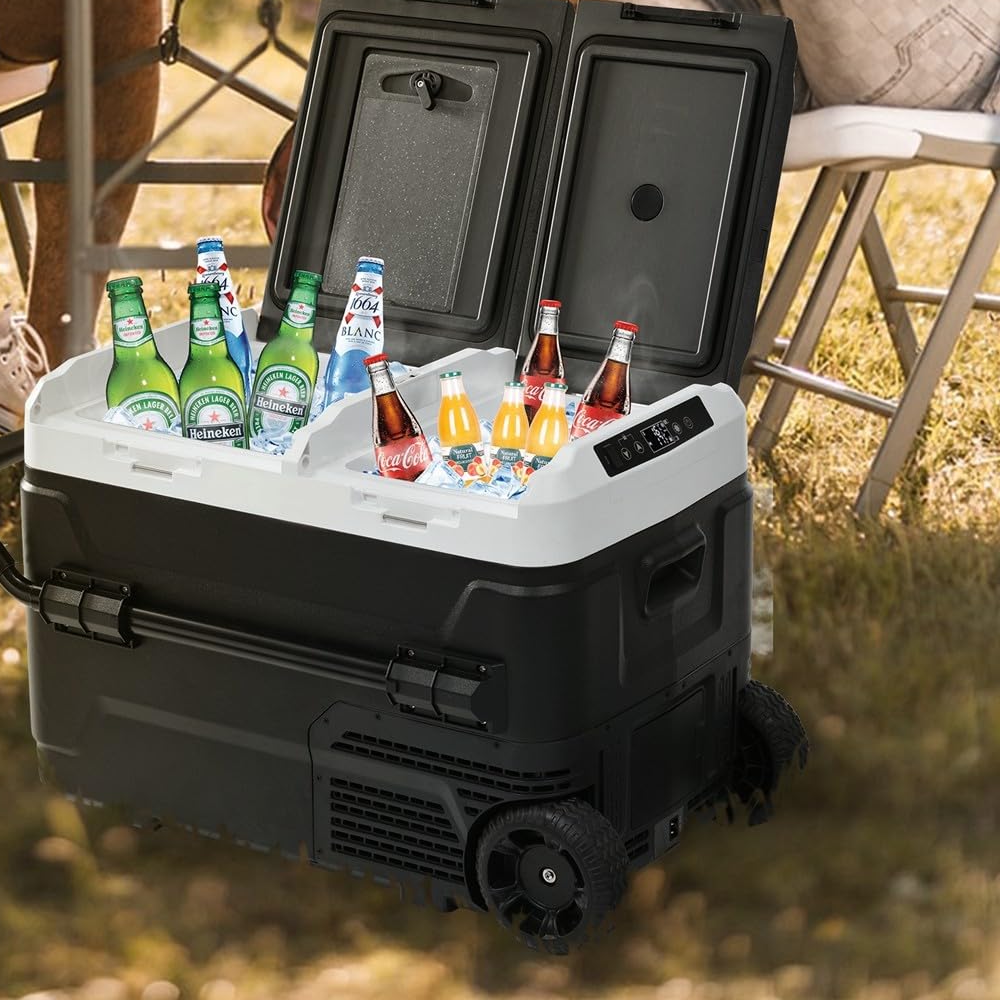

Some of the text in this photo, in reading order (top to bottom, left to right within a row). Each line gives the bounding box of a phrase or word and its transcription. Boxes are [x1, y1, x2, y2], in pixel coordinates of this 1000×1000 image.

[350, 296, 380, 314] 1664
[341, 326, 382, 341] BLANC
[144, 401, 165, 411] LAGER
[211, 395, 231, 406] LAGER
[256, 396, 305, 416] Heineken
[189, 427, 242, 439] Heineken
[452, 447, 473, 455] Natural
[501, 449, 519, 457] Natural
